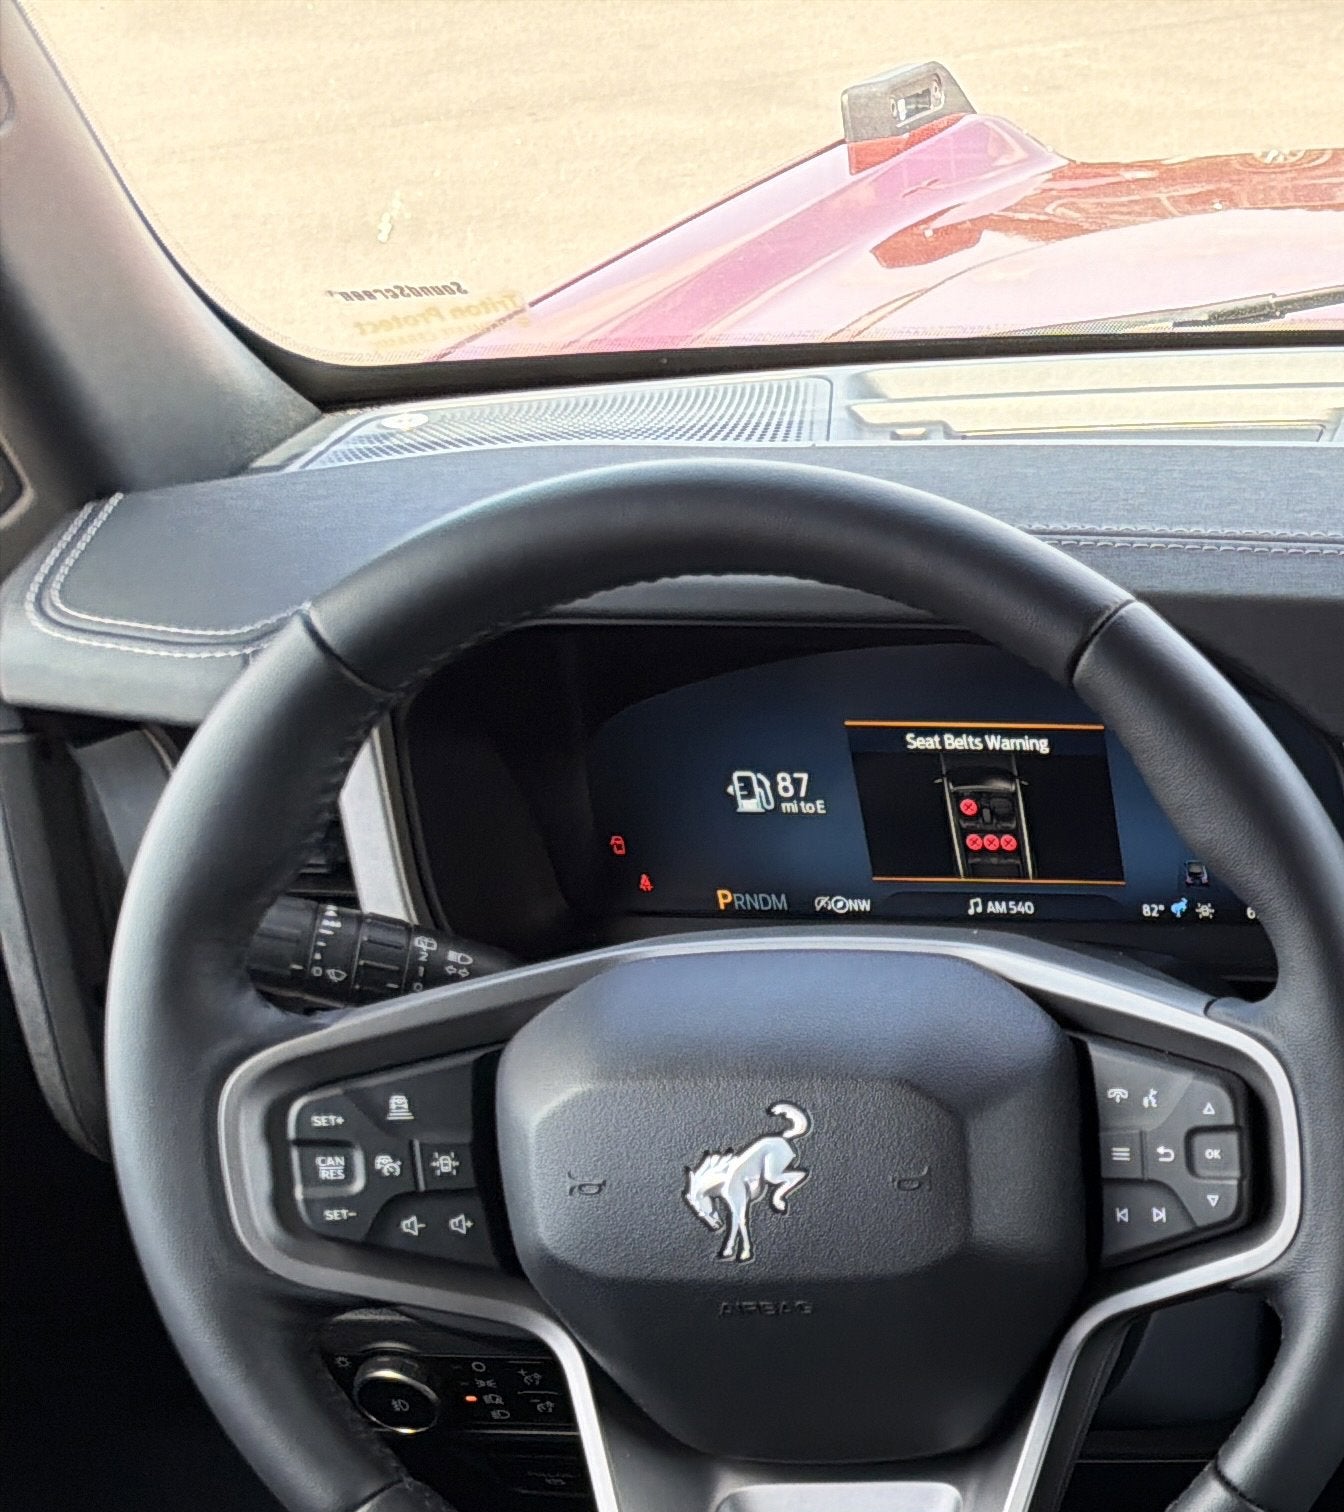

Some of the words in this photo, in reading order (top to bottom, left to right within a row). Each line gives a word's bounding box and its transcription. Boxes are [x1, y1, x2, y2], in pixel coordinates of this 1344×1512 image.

[906, 733, 940, 750] Seat
[944, 734, 982, 751] Belts
[984, 735, 1050, 754] Warning
[776, 772, 809, 798] 87
[716, 889, 788, 911] PRNDM
[849, 899, 871, 912] NW
[987, 901, 1007, 915] AM
[1010, 902, 1034, 915] 540
[1205, 1149, 1222, 1160] OK
[316, 1156, 345, 1167] CAN
[319, 1170, 345, 1180] RES
